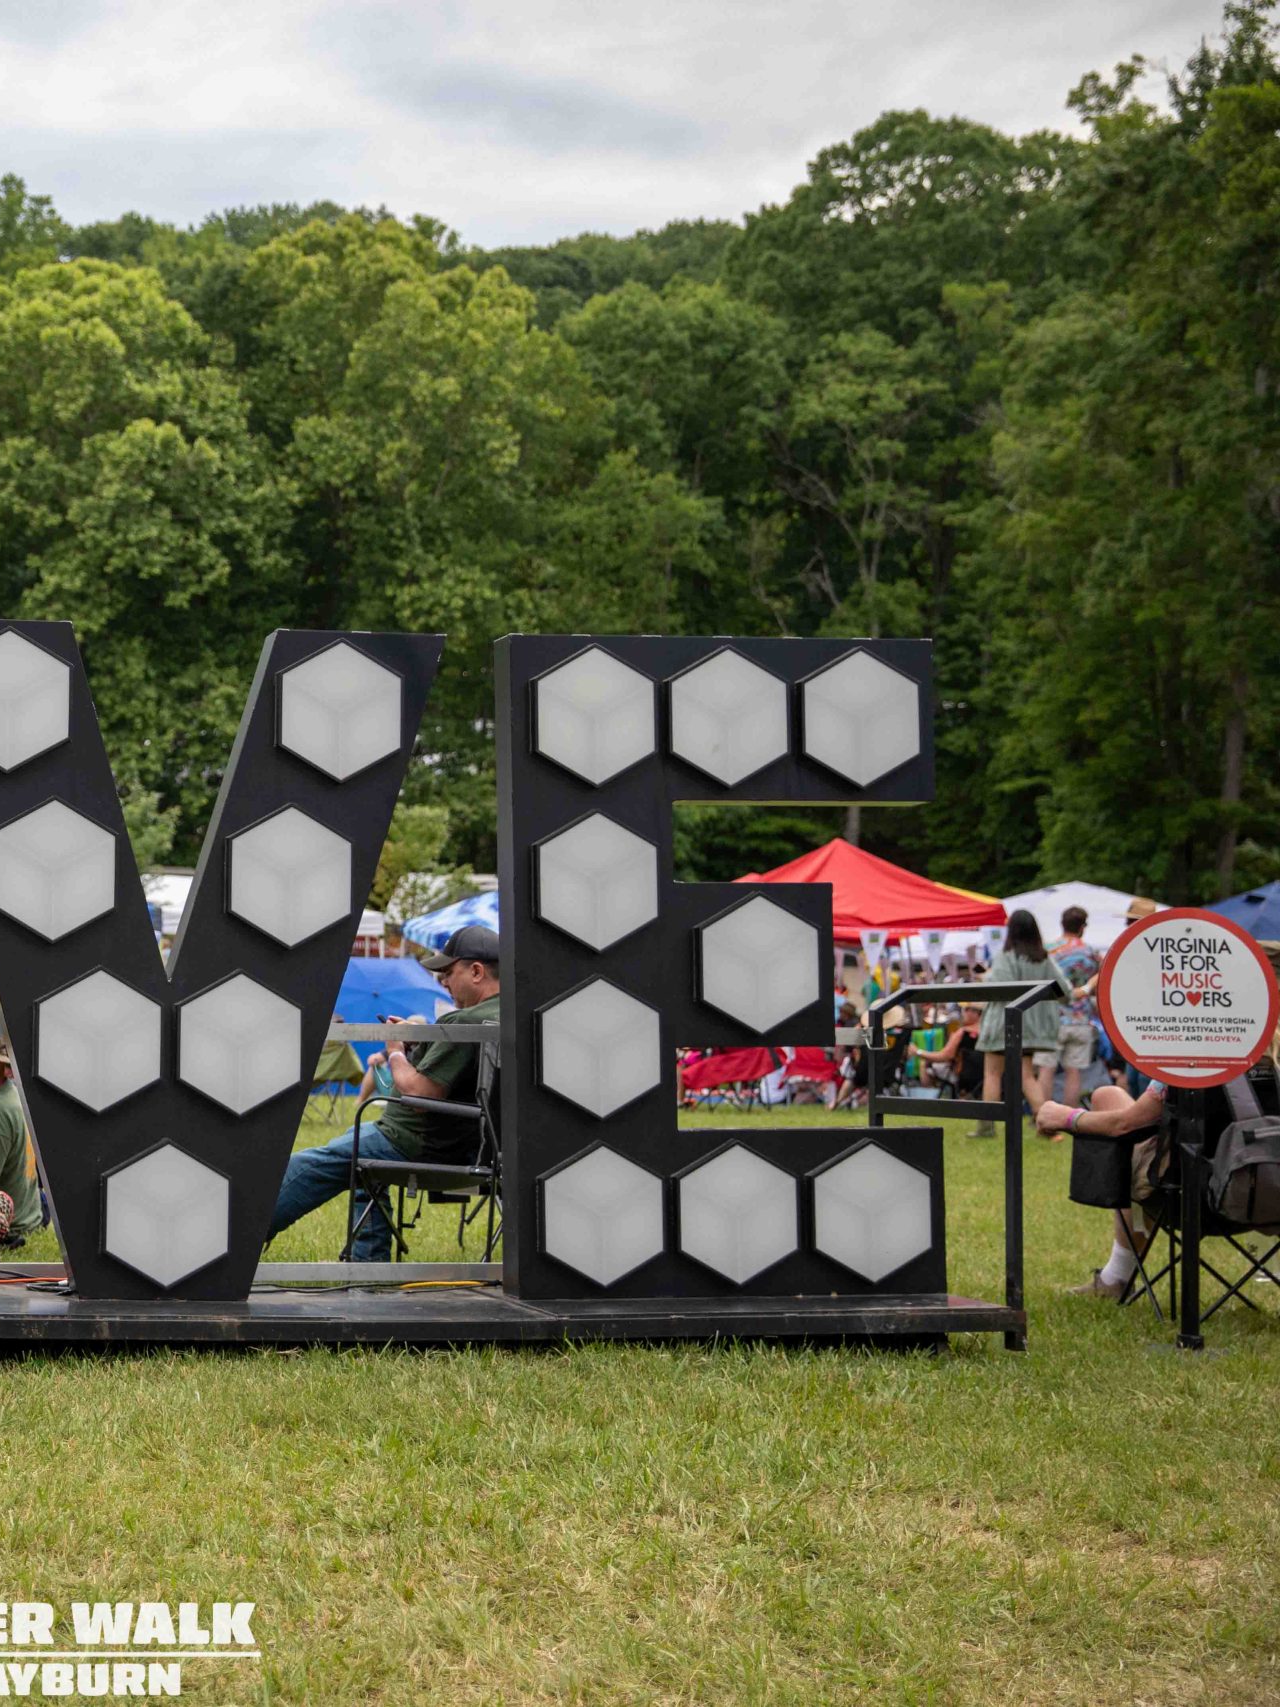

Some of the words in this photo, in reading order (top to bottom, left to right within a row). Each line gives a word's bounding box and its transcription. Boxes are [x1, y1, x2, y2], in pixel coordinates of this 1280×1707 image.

[1144, 937, 1232, 954] VIRGINIA
[1161, 955, 1175, 971] IS
[1181, 955, 1220, 971] FOR
[1161, 973, 1223, 989] MUSIC
[1154, 1016, 1177, 1024] YOUR
[1178, 1016, 1200, 1025] LOVE
[1201, 1017, 1218, 1025] FOR
[1135, 1025, 1161, 1033] MUSIC
[1182, 1026, 1223, 1034] FESTIVALS
[1141, 1034, 1183, 1042] #VAMUSIC
